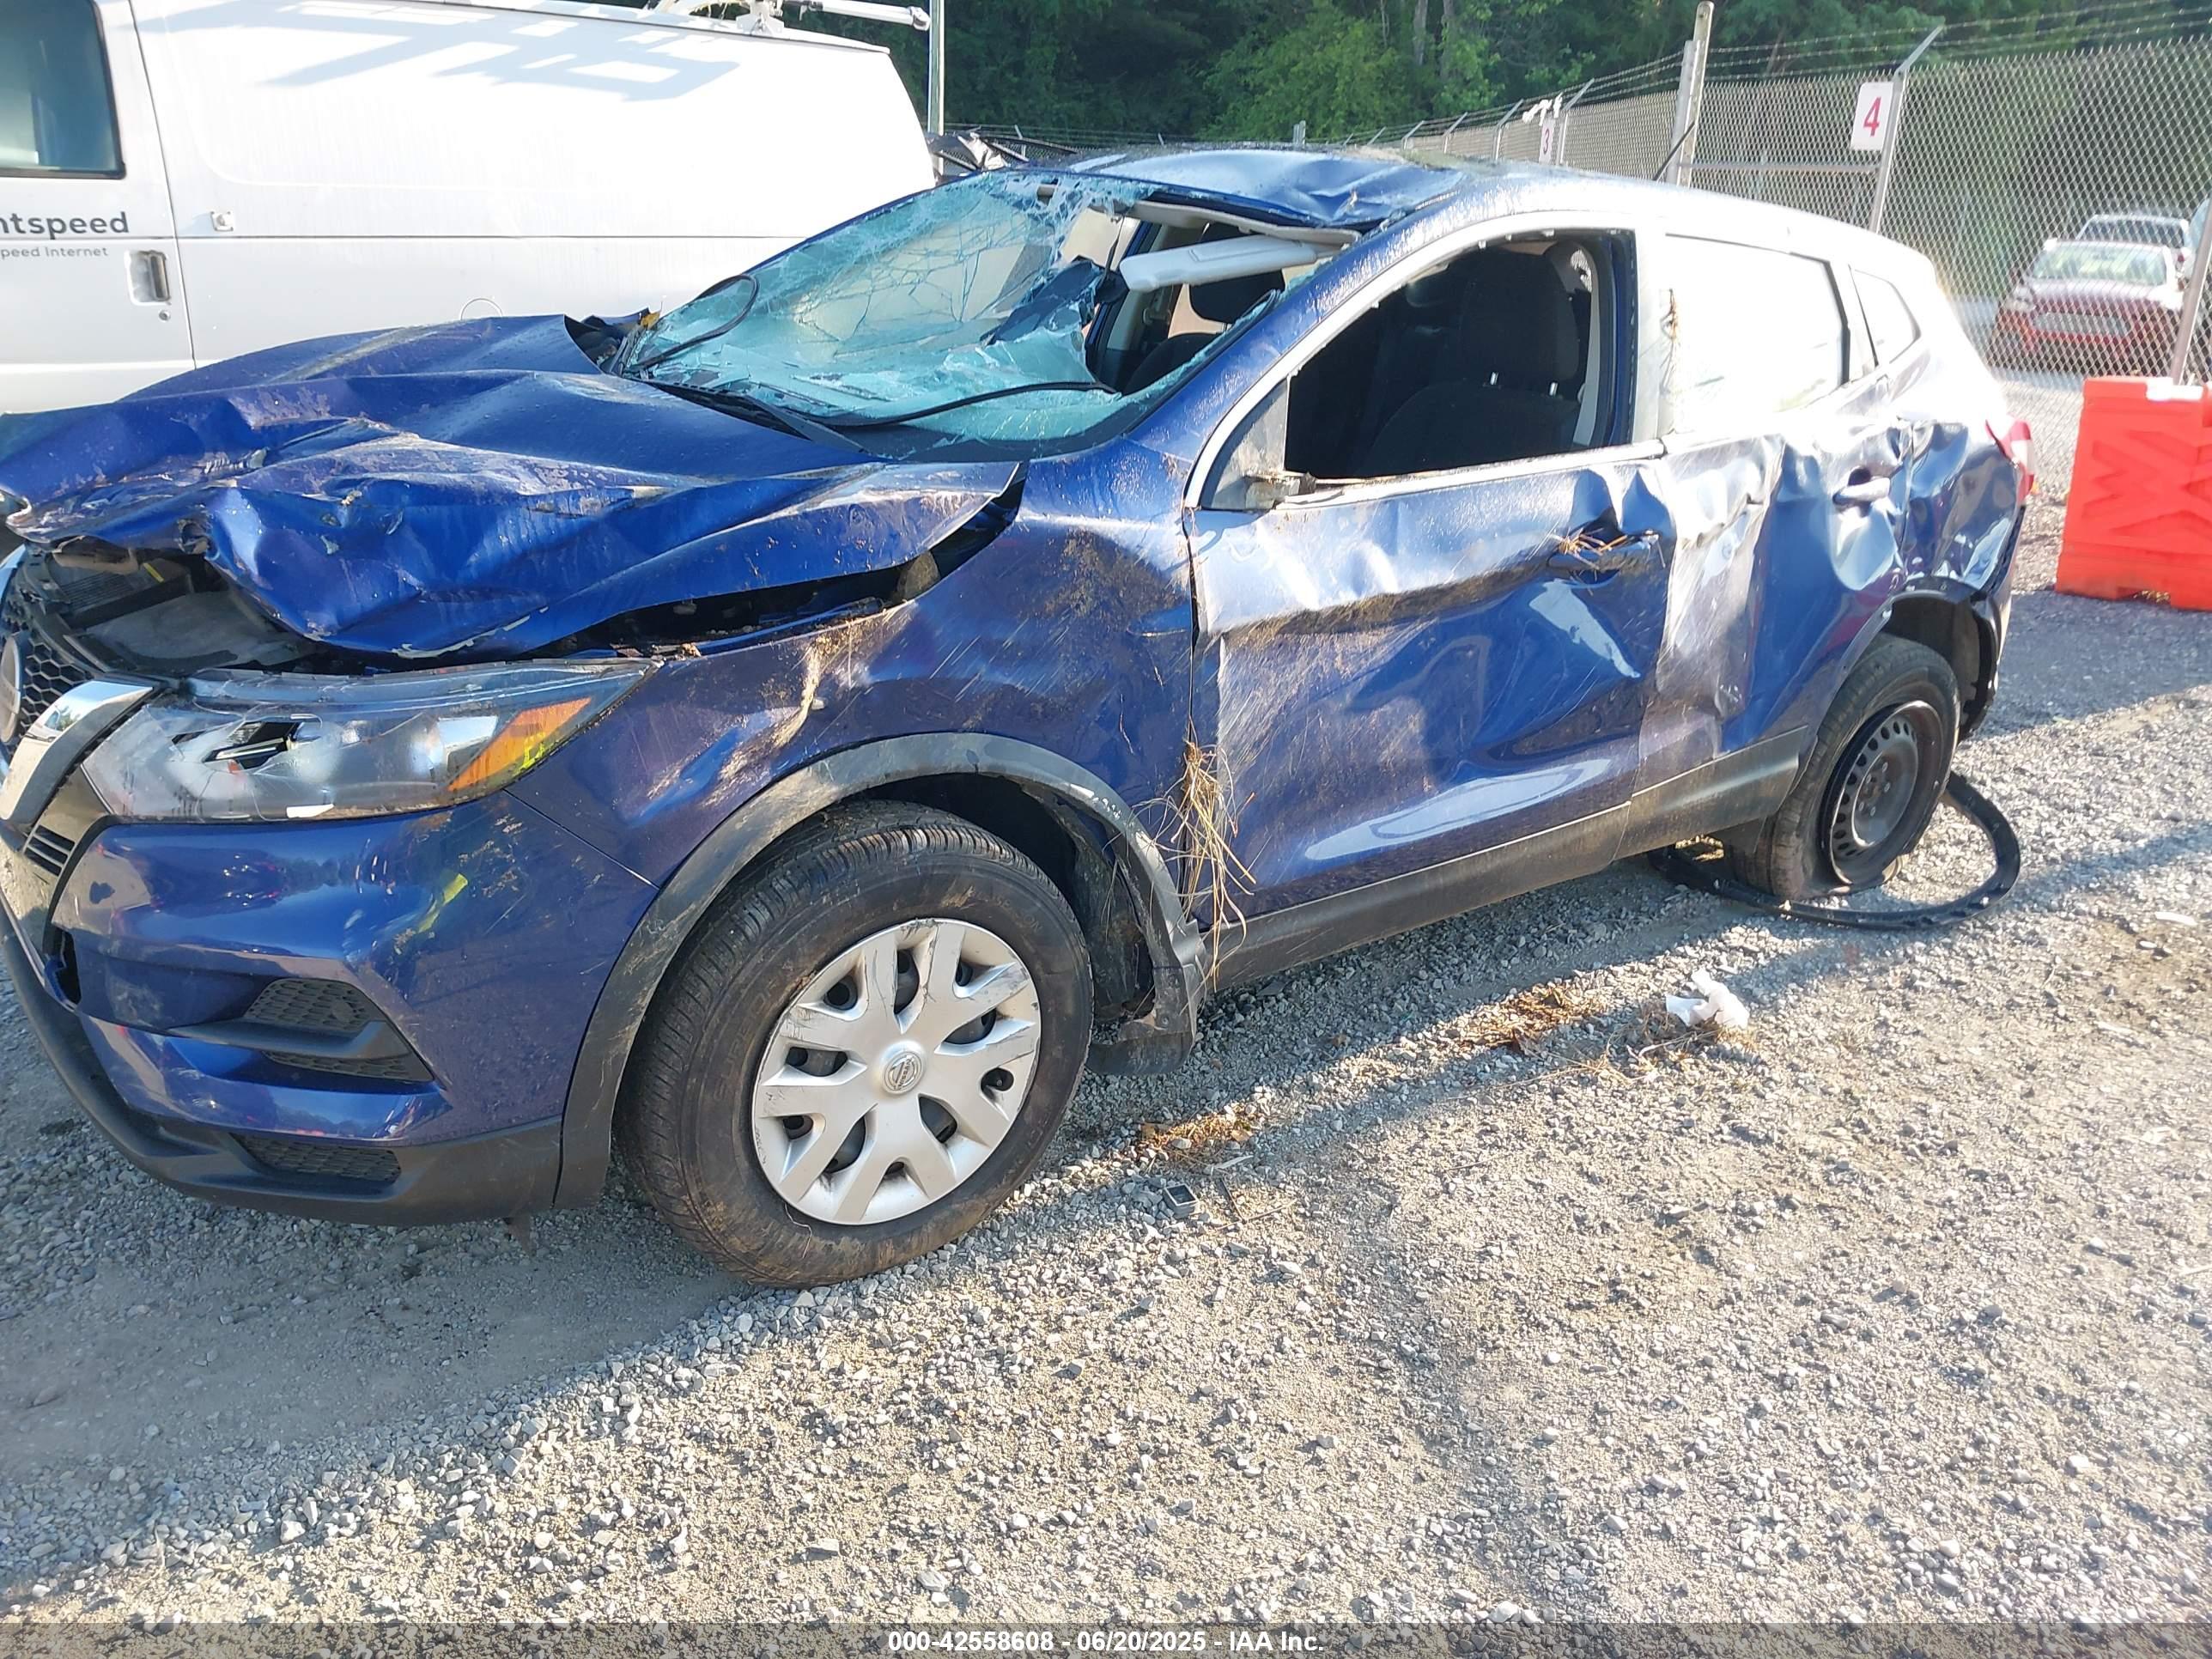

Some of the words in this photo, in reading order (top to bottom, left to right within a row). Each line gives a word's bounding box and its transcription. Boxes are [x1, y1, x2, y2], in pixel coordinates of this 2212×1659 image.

[1863, 96, 1882, 137] 4
[1542, 128, 1550, 155] 3
[45, 246, 109, 258] Internet
